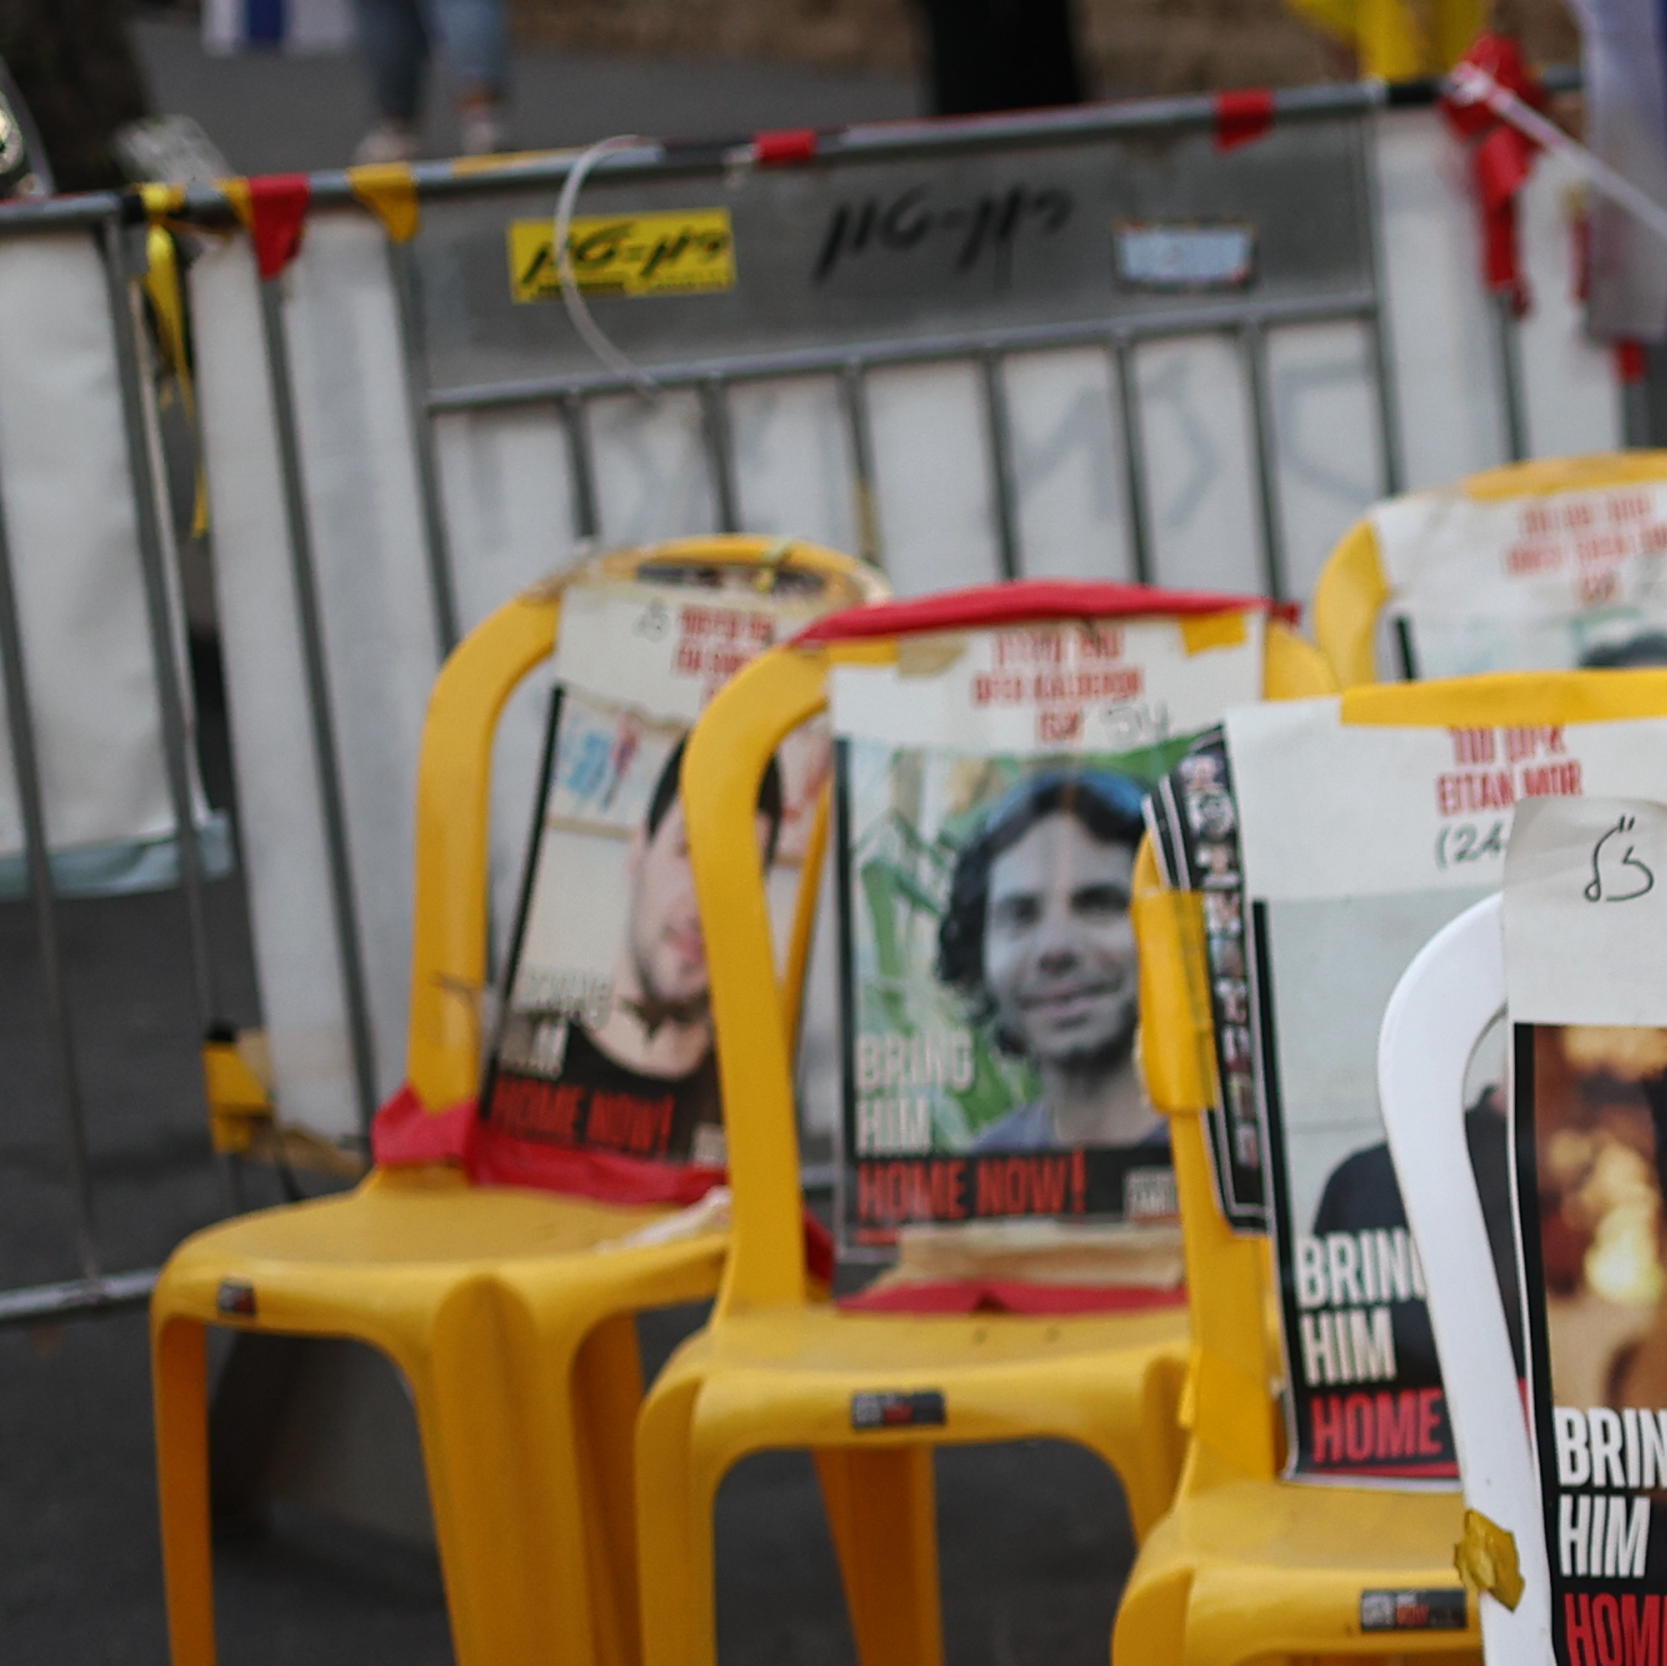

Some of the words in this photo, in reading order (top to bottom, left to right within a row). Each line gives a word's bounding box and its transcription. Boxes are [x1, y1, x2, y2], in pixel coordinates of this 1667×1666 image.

[1437, 773, 1513, 817] EITAN
[858, 1159, 968, 1220] HOME
[976, 1147, 1087, 1217] NOW!
[1302, 1307, 1397, 1386] HIM
[1311, 1387, 1445, 1464] HOME
[1558, 1494, 1651, 1579] HIM
